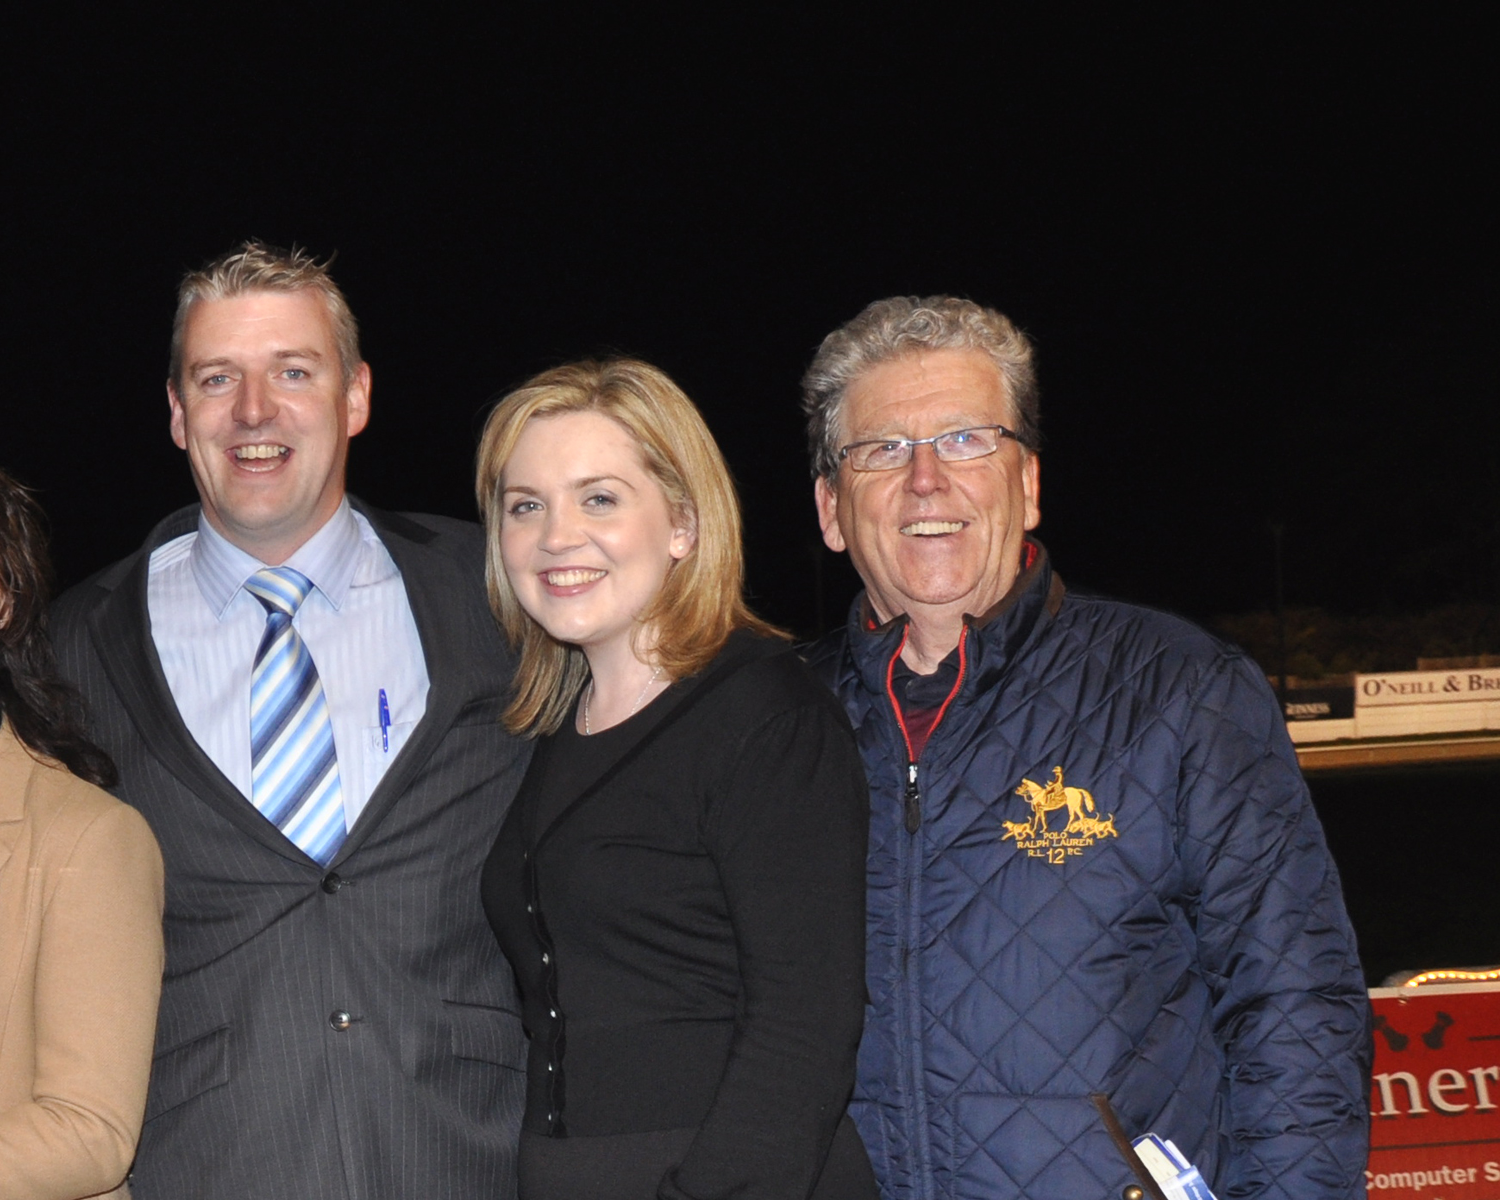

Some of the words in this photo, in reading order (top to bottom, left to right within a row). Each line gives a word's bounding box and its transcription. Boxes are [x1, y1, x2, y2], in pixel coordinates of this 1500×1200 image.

[1442, 675, 1461, 692] &
[1043, 831, 1068, 840] POLO
[1016, 839, 1049, 849] RALPH
[1052, 838, 1093, 847] LAUREN
[1046, 848, 1065, 864] 12
